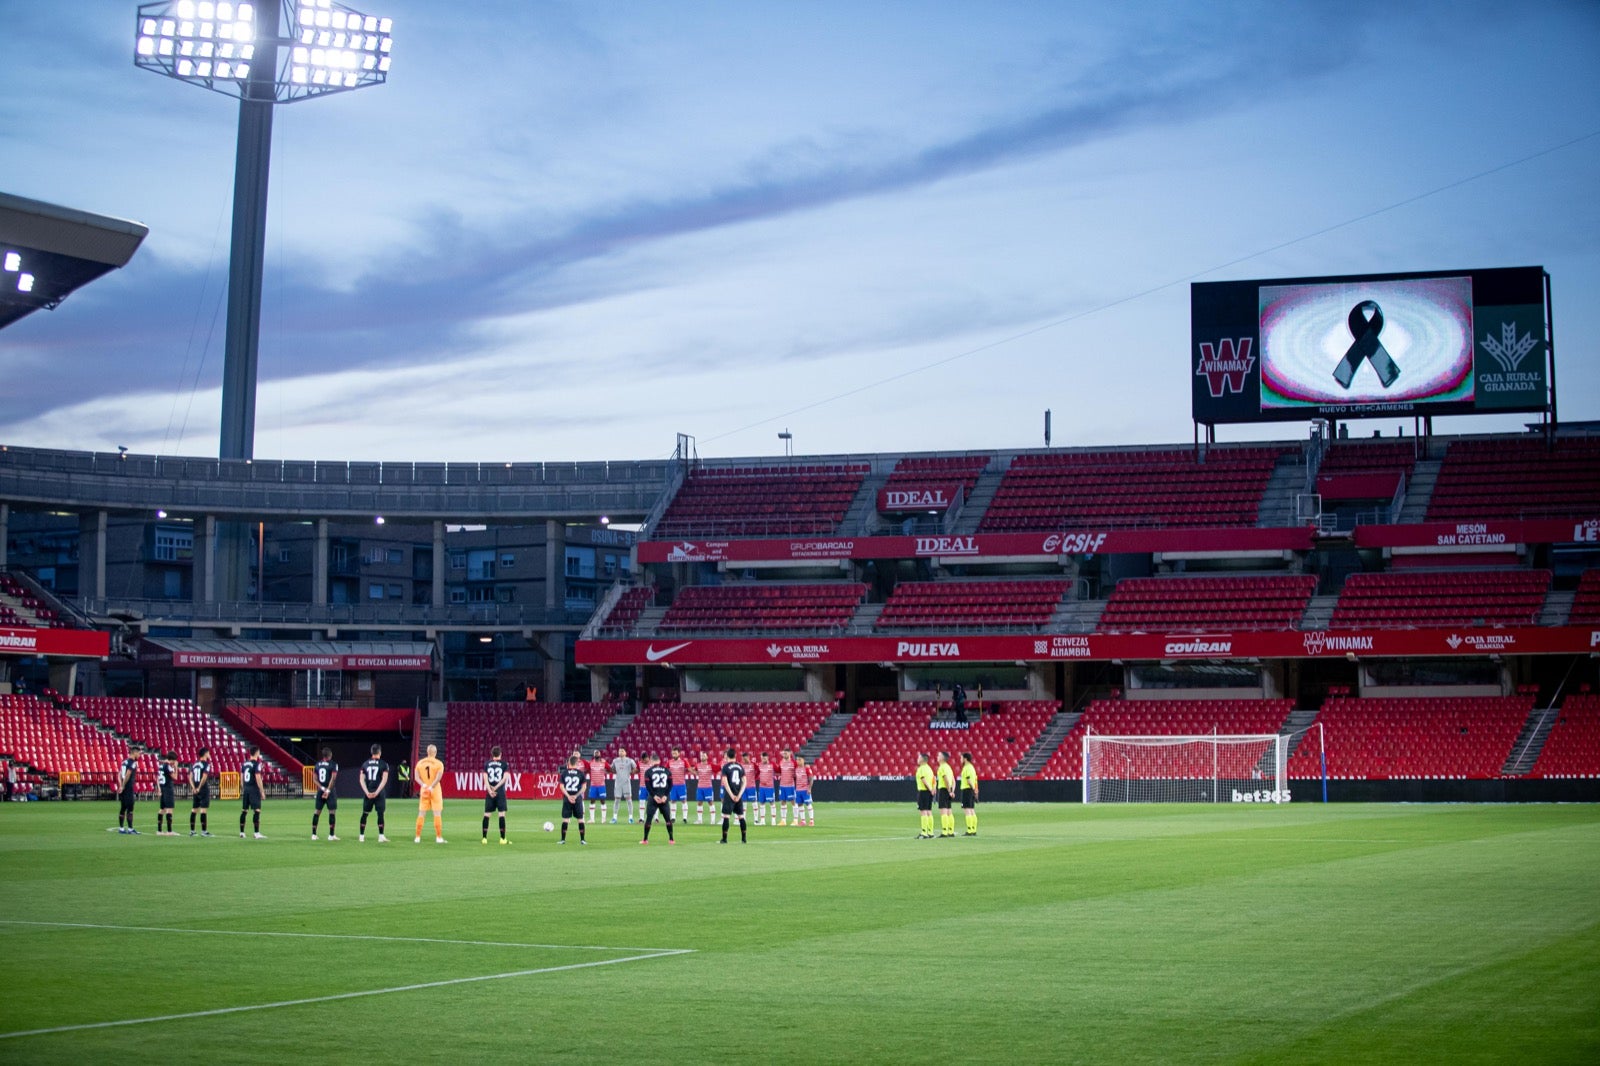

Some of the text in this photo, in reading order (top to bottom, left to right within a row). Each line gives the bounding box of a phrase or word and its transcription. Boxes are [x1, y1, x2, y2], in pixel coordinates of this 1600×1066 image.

[1205, 359, 1247, 372] WINAMAX
[1480, 371, 1541, 382] CAJA RURAL
[1484, 382, 1536, 392] GRANADA
[1370, 402, 1414, 411] CARMENES
[886, 490, 947, 505] IDEAL
[1456, 523, 1487, 534] MESÓN
[1584, 518, 1600, 528] RÓ
[1574, 524, 1600, 541] LE
[916, 537, 978, 552] IDEAL
[1437, 534, 1505, 545] SAN CAYETANO
[1053, 637, 1089, 647] CERVEZAS
[1325, 636, 1373, 650] WINAMAX
[1465, 635, 1516, 644] CAJA RURAL
[783, 644, 829, 653] CAJA RURAL
[897, 641, 960, 657] PULEVA
[1051, 647, 1091, 657] ALHAMBRA
[190, 655, 216, 664] CERVEZAS
[218, 656, 248, 665] ALHAMBRA
[272, 657, 300, 665] CERVEZAS
[302, 657, 333, 666] ALHAMBRA
[358, 658, 386, 666] CERVEZAS
[388, 658, 420, 667] ALHAMBRA
[930, 721, 969, 729] #FANCAM
[244, 767, 250, 783] 6
[318, 768, 326, 782] 8
[366, 766, 379, 781] 17
[425, 765, 430, 780] 1
[487, 768, 503, 782] 33
[732, 770, 740, 785] 4
[454, 772, 522, 791] WINAX
[564, 776, 580, 792] 22
[652, 774, 668, 788] 23
[1232, 789, 1291, 802] bet365
